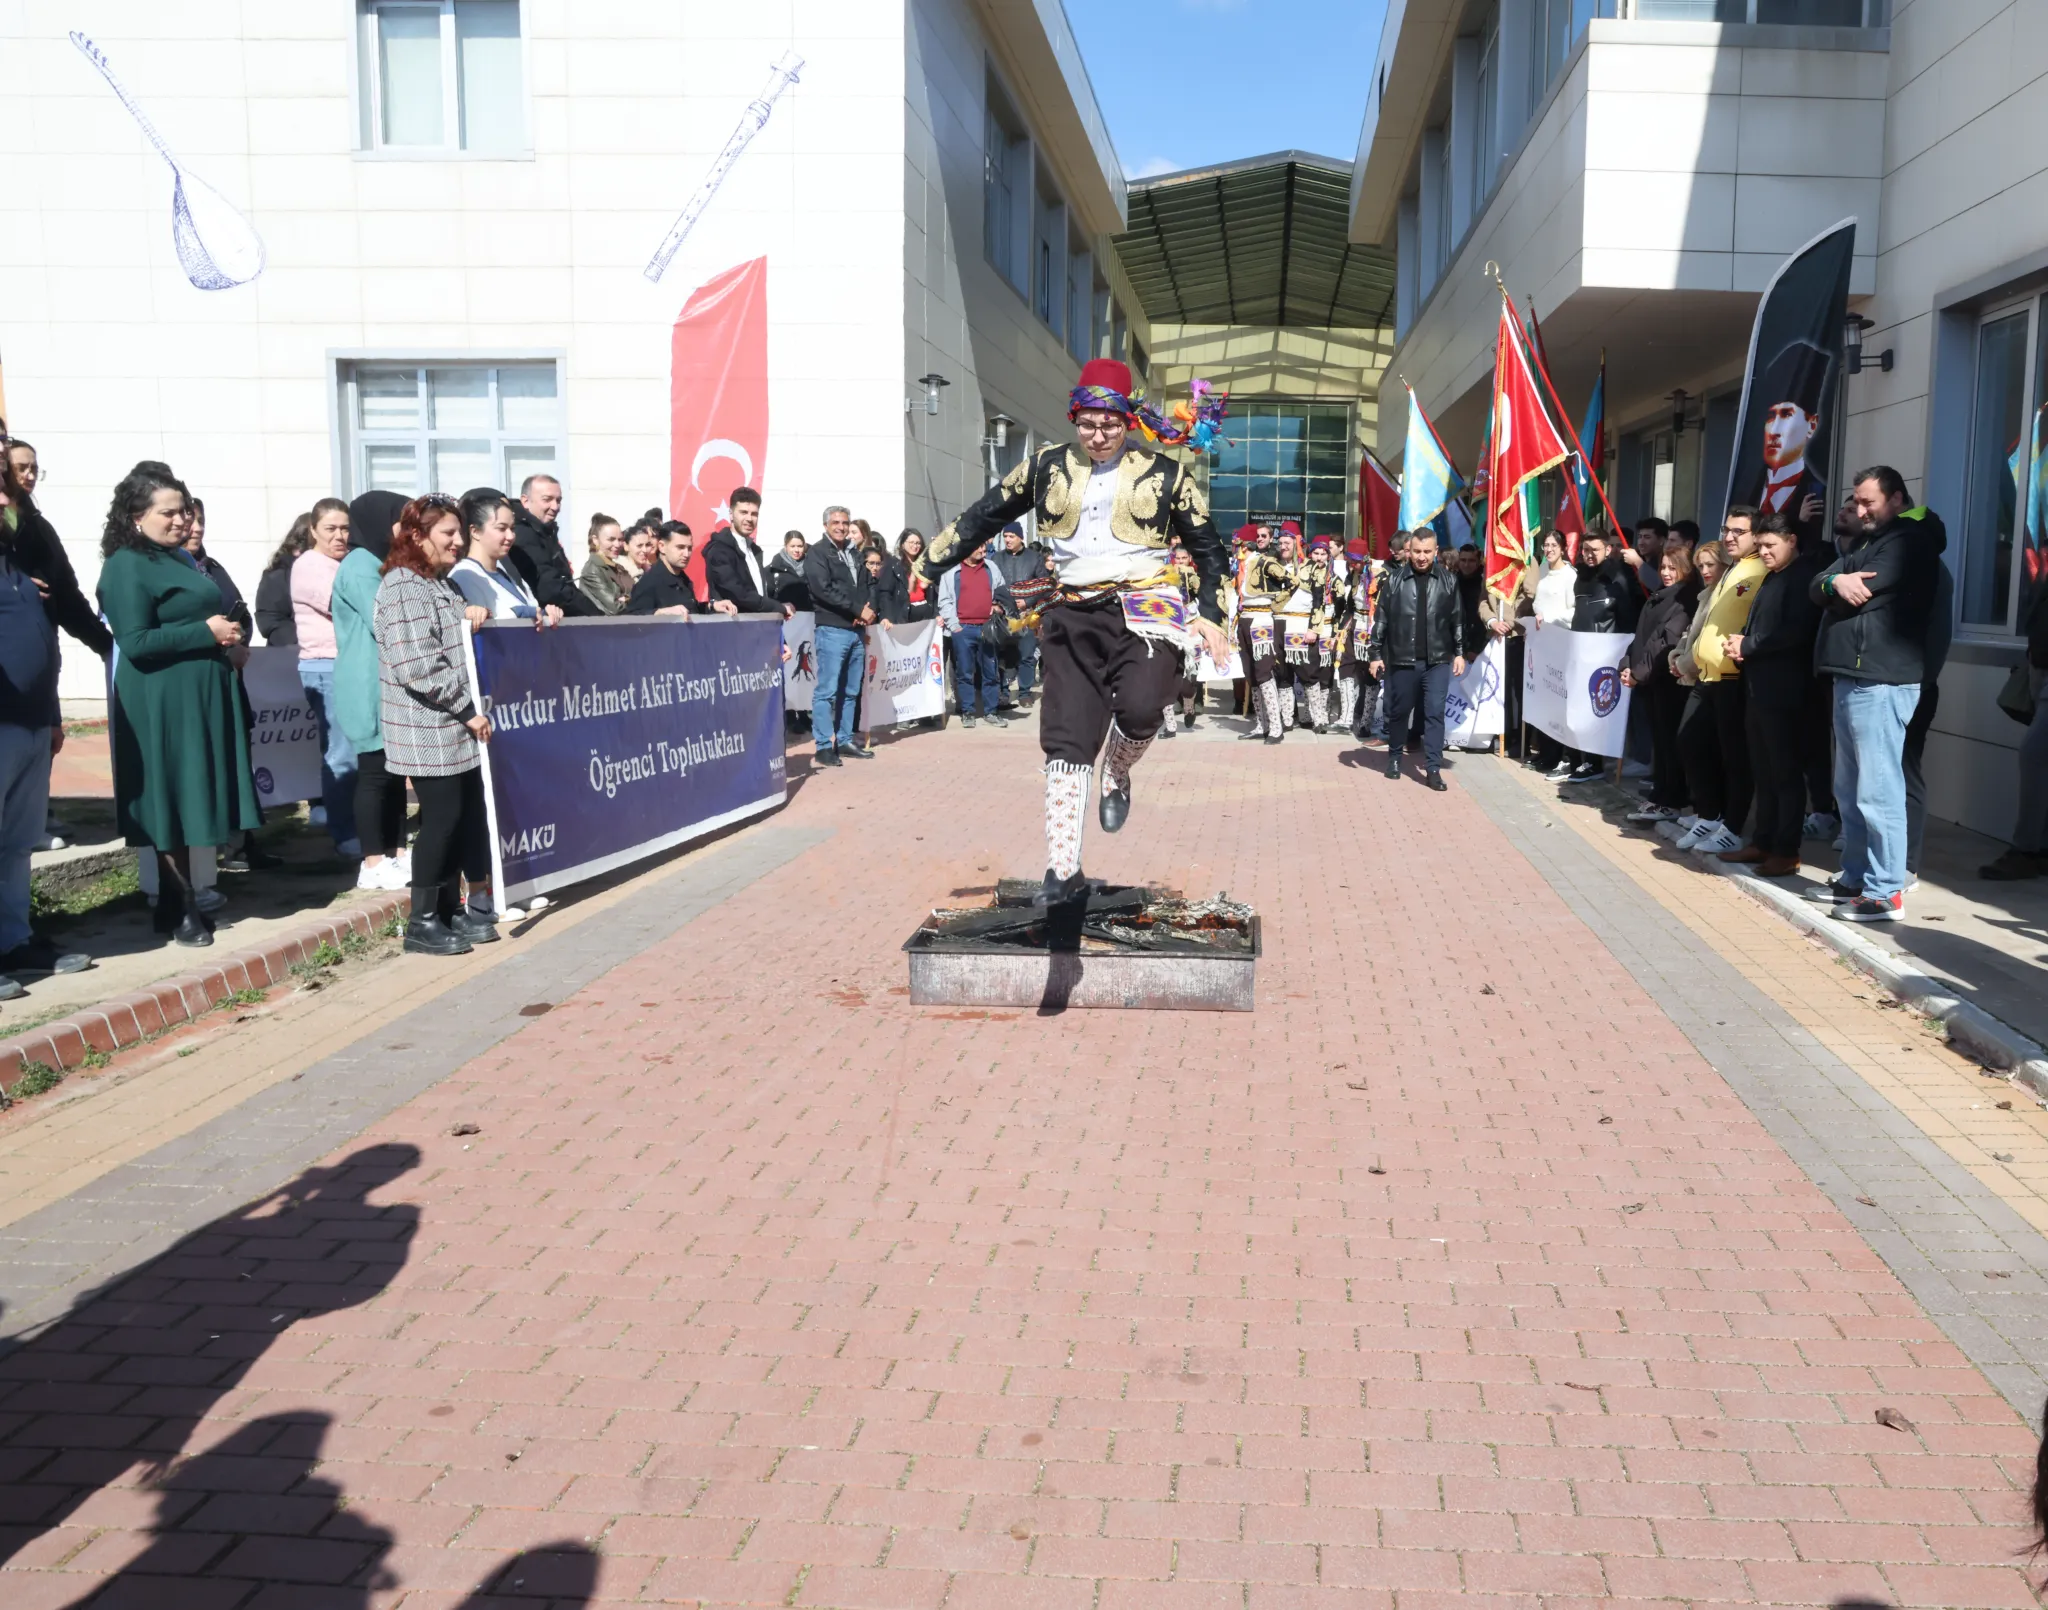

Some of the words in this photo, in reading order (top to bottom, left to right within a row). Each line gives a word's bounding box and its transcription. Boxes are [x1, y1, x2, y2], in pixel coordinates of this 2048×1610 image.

[903, 656, 922, 671] SPOR
[481, 689, 557, 732] Burdur
[562, 682, 637, 721] Mehmet
[640, 672, 674, 709] Akif
[675, 673, 716, 705] Ersoy
[589, 742, 656, 798] Öğrenci
[657, 729, 745, 777] Toplulukları
[501, 823, 555, 860] MAKÜ
